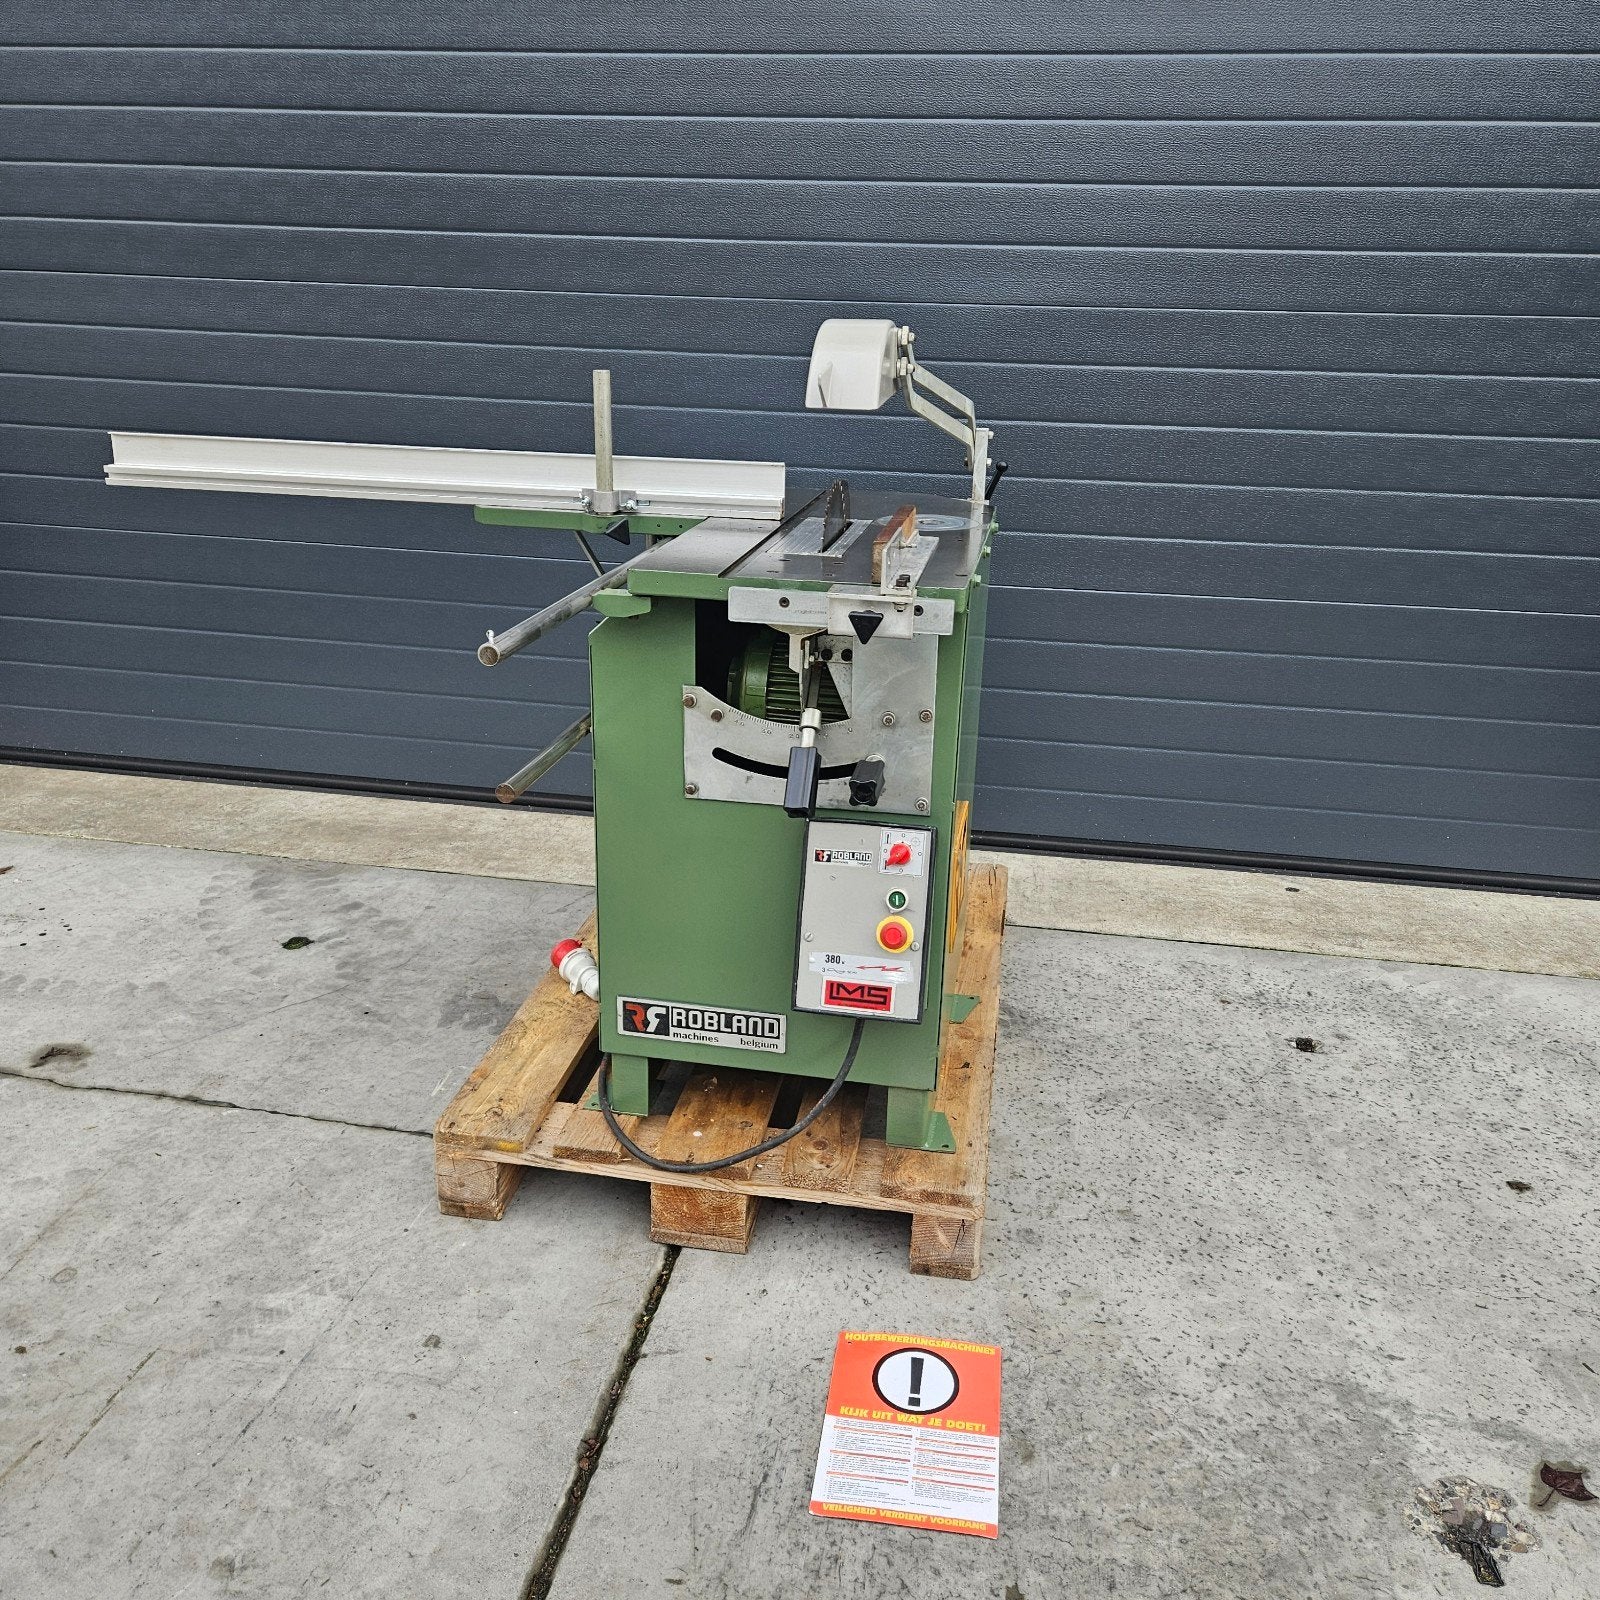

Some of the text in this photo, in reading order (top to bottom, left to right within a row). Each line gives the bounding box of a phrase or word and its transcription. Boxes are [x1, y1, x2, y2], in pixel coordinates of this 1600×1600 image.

[832, 851, 872, 861] ROBLAND
[830, 983, 888, 1005] LMS
[672, 1007, 779, 1038] ROBLAND
[673, 1031, 778, 1050] machines belgium
[844, 1332, 996, 1355] HOUTBEWERKINGSMACHINES
[839, 1405, 987, 1432] KIJK UIT WAT JE DOET!
[822, 1502, 988, 1531] VEILIGHEID VERDIENT VOORRANG
